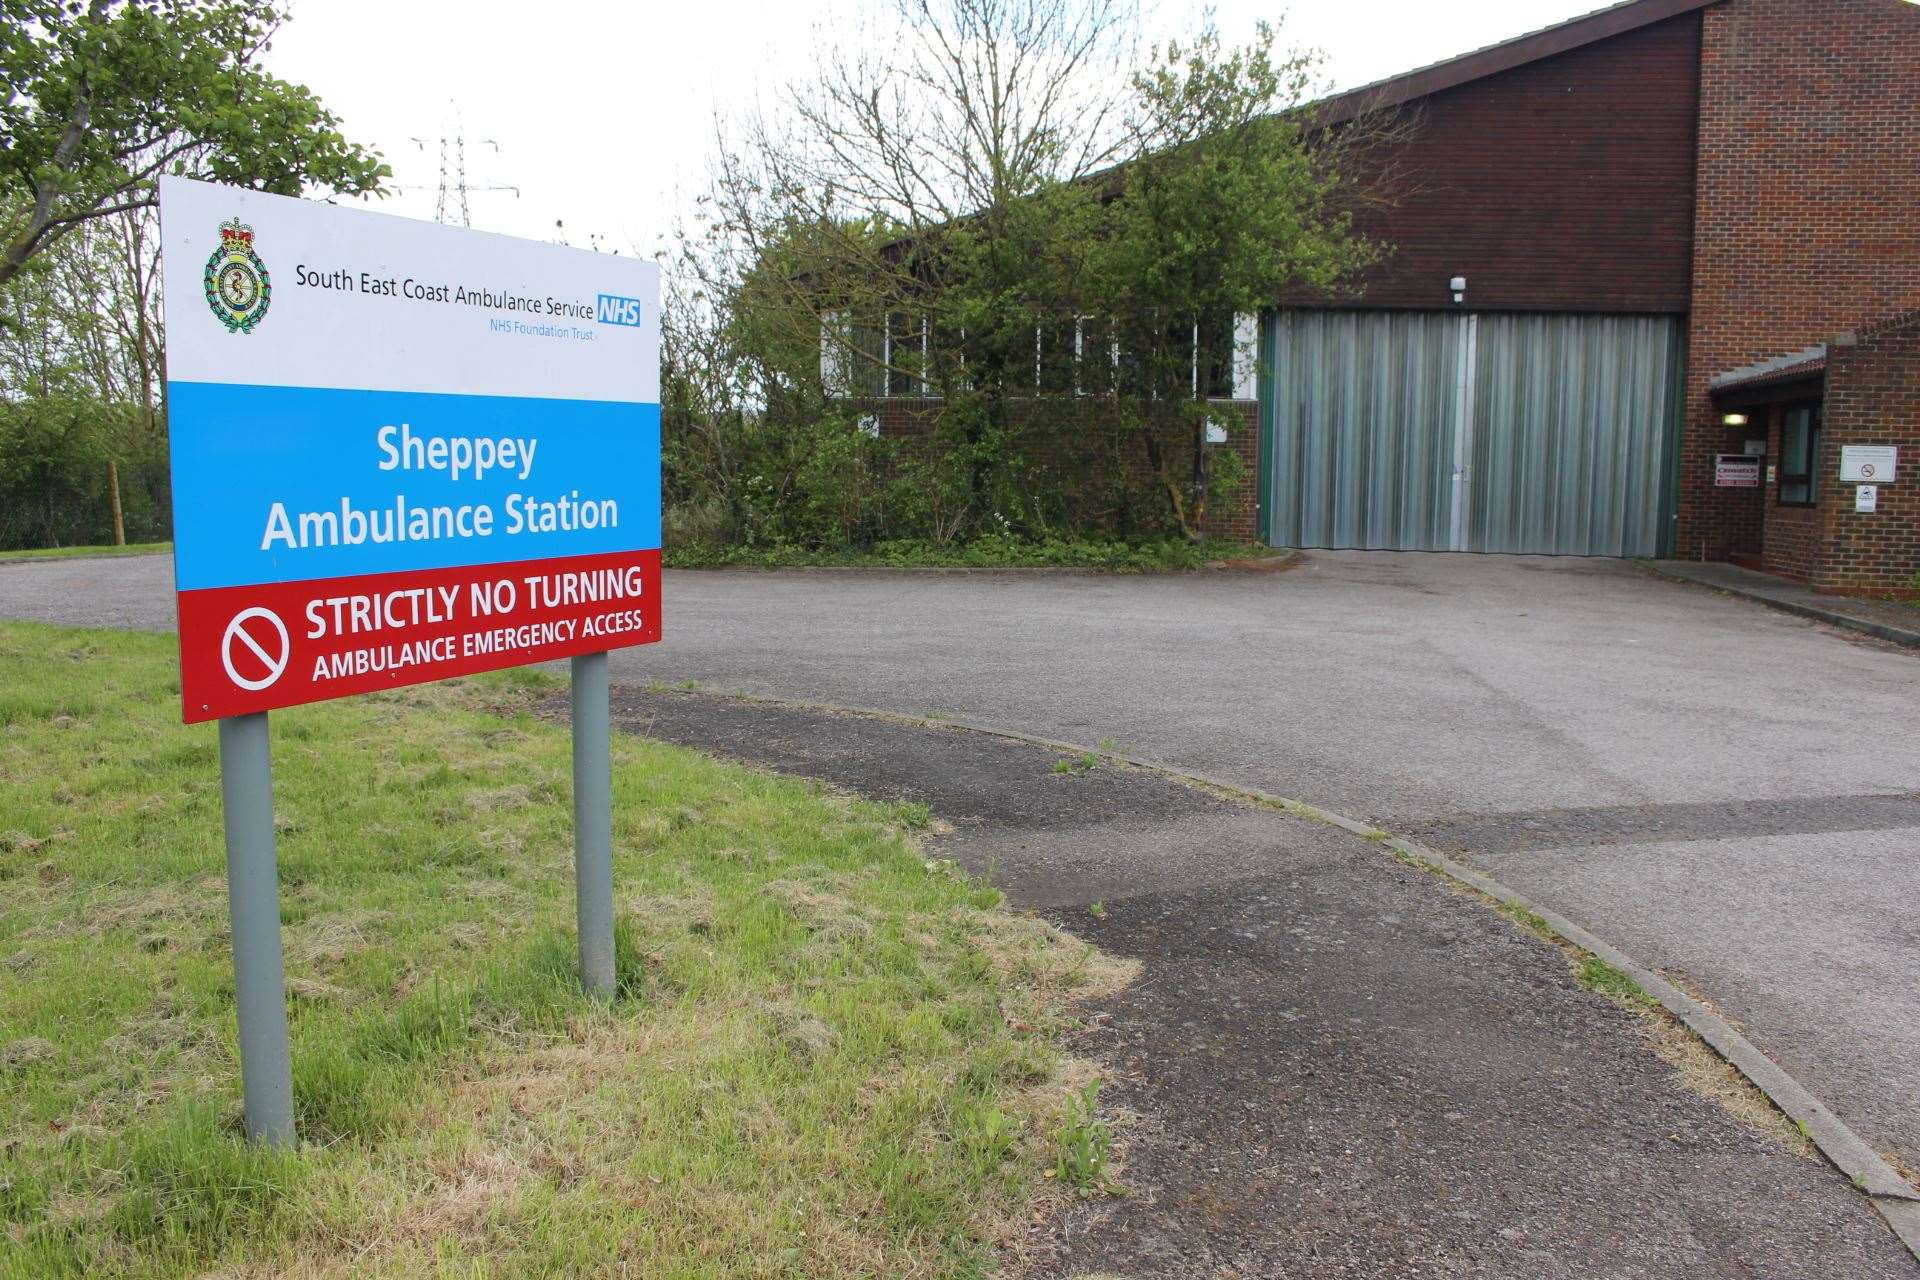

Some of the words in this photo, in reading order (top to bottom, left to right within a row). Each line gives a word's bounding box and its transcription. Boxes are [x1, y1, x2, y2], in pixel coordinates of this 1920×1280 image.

[295, 264, 354, 291] South
[360, 272, 398, 297] East
[403, 279, 450, 303] Coast
[454, 285, 542, 314] Ambulance
[546, 297, 594, 320] Service
[599, 297, 639, 325] NHS
[489, 318, 512, 333] NHS
[513, 320, 569, 339] Foundation
[571, 327, 593, 341] Trust
[378, 424, 537, 480] Sheppey
[261, 496, 494, 551] Ambulance
[505, 491, 618, 535] Station
[305, 584, 460, 639] STRICTLY
[470, 579, 517, 617] NO
[524, 566, 642, 609] TURNING
[312, 636, 457, 682] AMBULANCE
[463, 618, 578, 657] EMERGENCY
[581, 610, 642, 638] ACCESS
